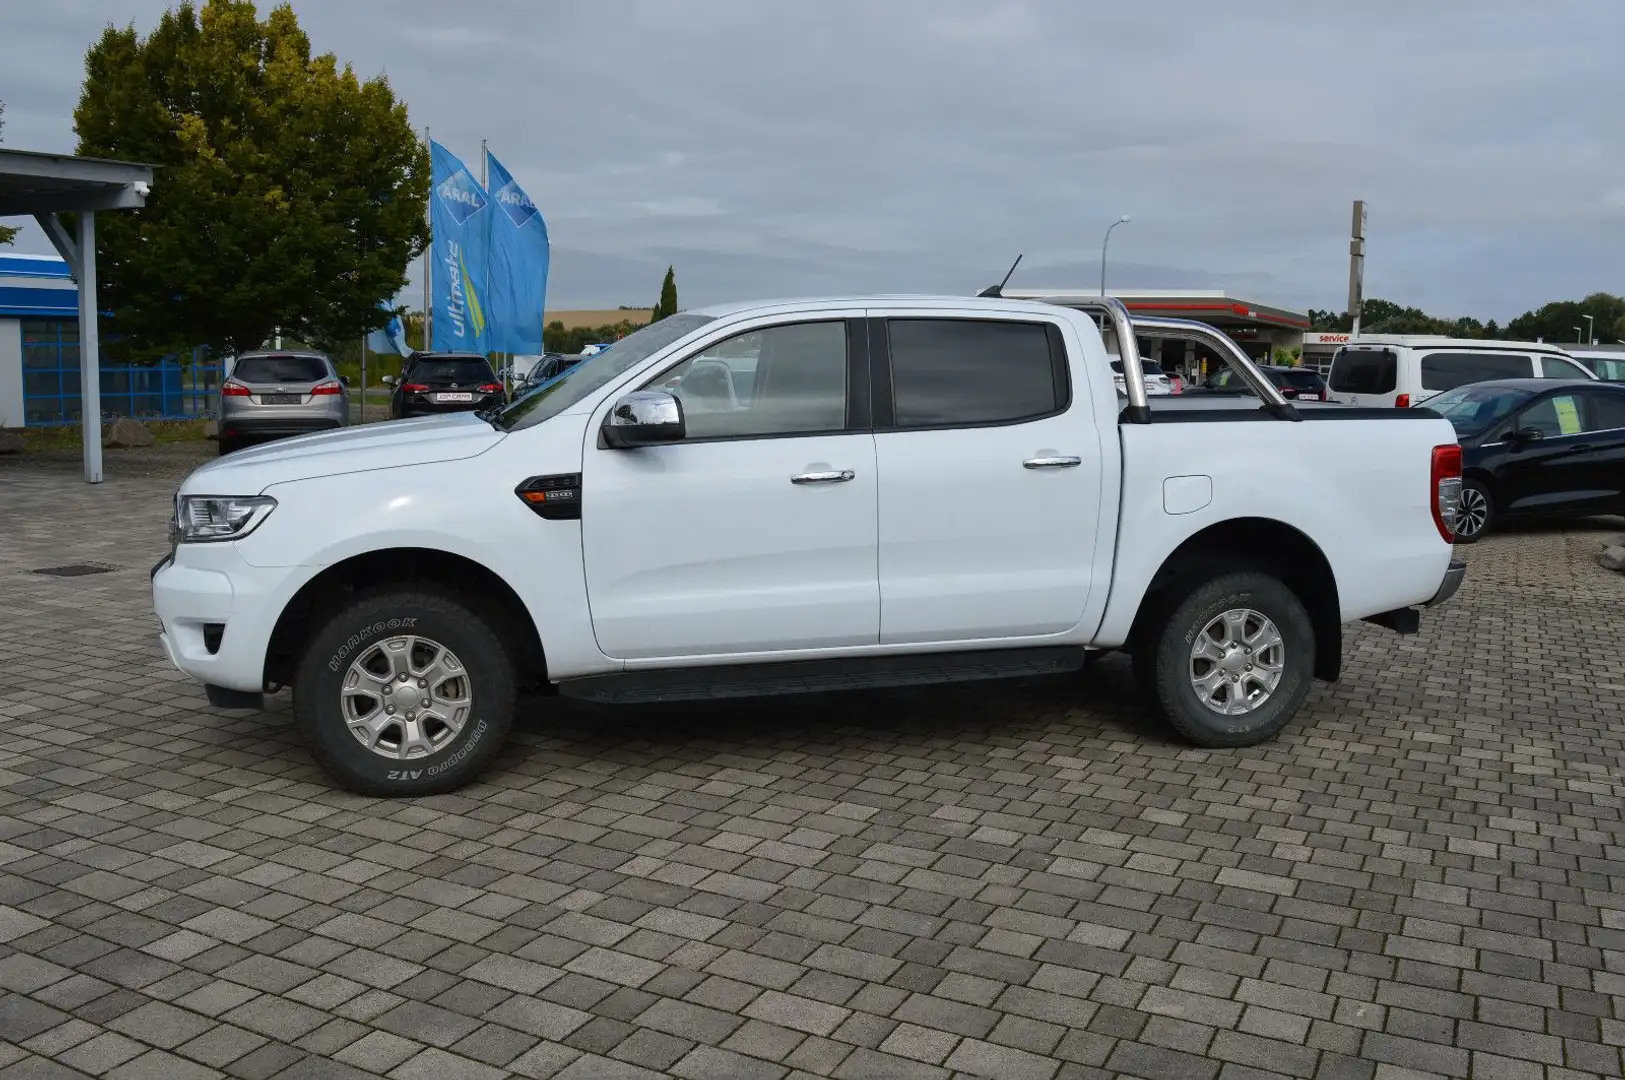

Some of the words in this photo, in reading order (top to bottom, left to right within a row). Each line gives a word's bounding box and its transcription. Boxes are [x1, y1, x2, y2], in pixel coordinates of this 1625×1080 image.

[442, 185, 480, 208] ARAL
[445, 239, 465, 338] ultimate
[1319, 333, 1349, 343] service
[387, 768, 424, 780] AT2
